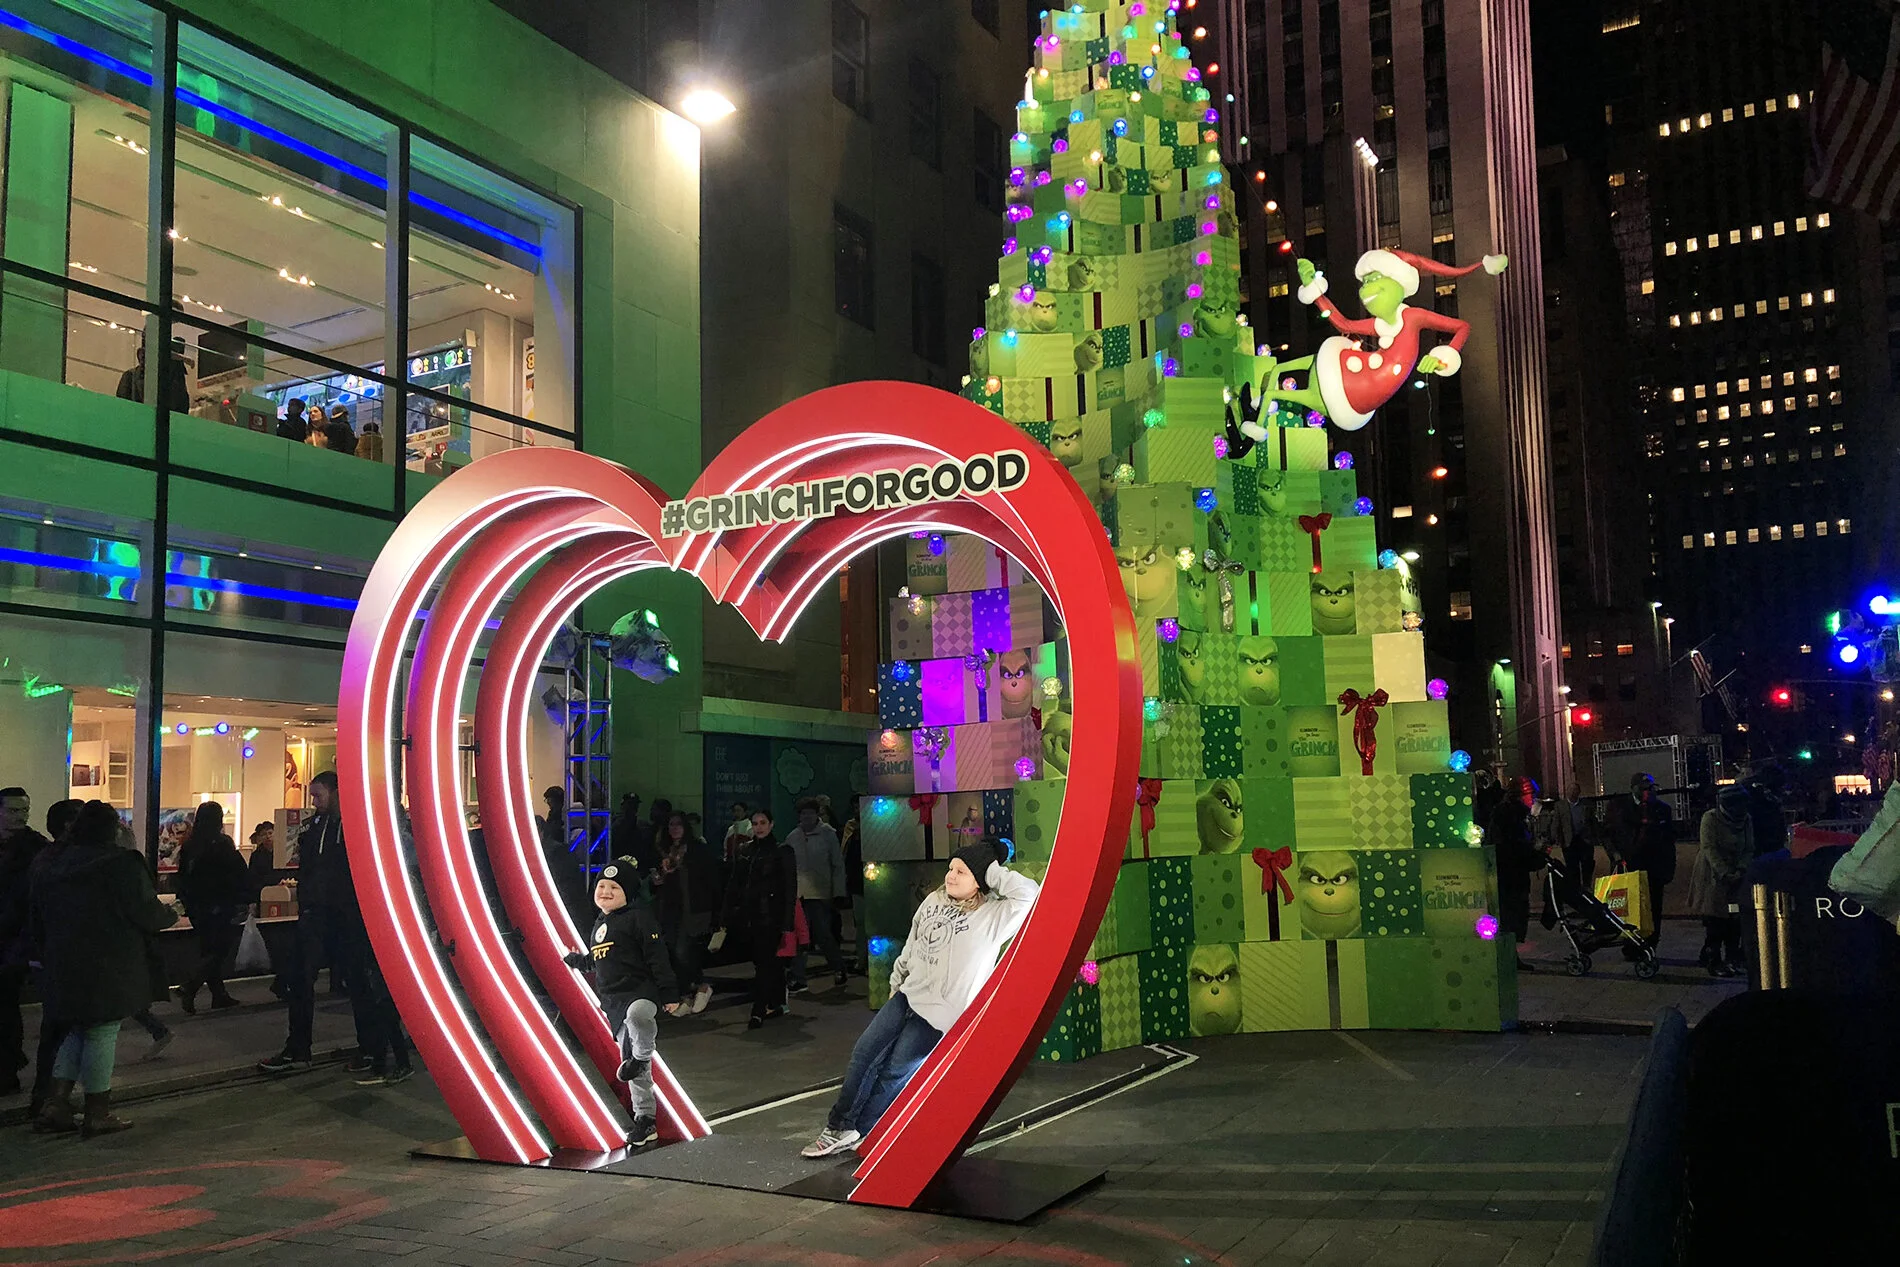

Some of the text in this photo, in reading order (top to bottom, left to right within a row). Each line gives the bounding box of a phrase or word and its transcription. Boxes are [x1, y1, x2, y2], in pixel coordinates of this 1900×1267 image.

[662, 451, 1028, 536] #GRINCHFORGOOD
[1291, 740, 1338, 757] GRINCH
[1395, 736, 1450, 753] GRINCH
[1424, 890, 1486, 909] GRINCH
[593, 946, 610, 961] PIT
